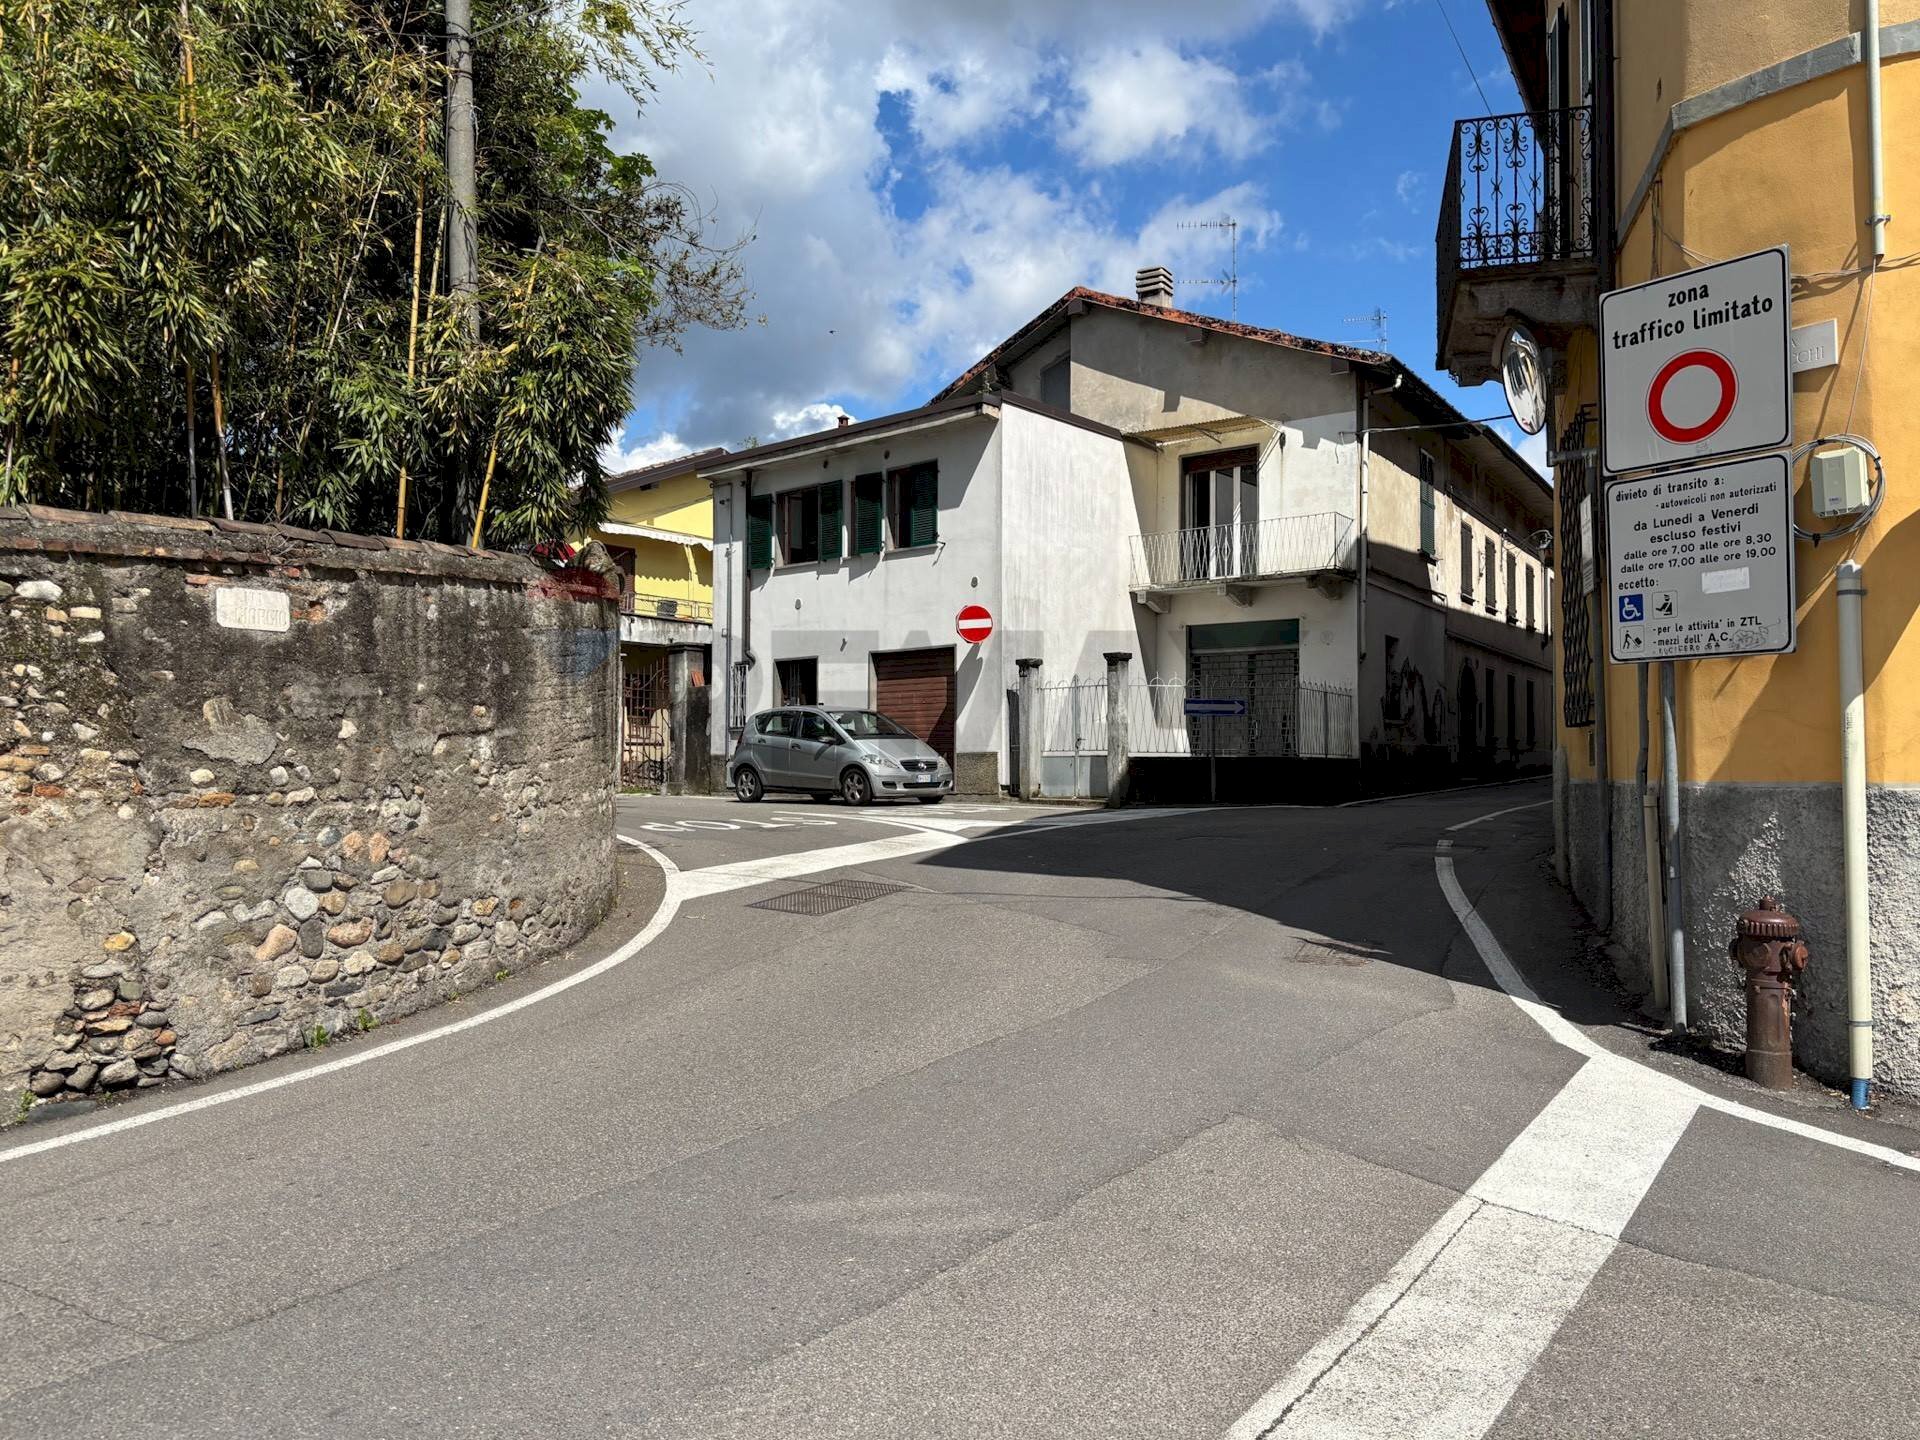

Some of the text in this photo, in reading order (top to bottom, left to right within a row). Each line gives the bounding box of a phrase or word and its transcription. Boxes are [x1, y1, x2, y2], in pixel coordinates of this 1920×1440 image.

[1668, 284, 1709, 308] zona
[1612, 295, 1773, 349] traffico limitato
[1615, 477, 1725, 502] divieto di transito a:
[1710, 491, 1726, 501] non
[1729, 481, 1777, 499] autorizzati
[1633, 502, 1759, 532] da Lunedi a Venerdi
[1650, 521, 1741, 544] escluso festivi
[1623, 550, 1648, 561] dalle
[1651, 548, 1668, 557] ore
[1699, 539, 1719, 551] alle
[1723, 539, 1741, 548] ore
[1620, 563, 1644, 574] dalle
[1648, 562, 1664, 570] ore
[1699, 553, 1719, 564] alle
[1723, 552, 1741, 561] ore
[1618, 577, 1660, 591] eccetto:
[1675, 622, 1684, 632] le
[1727, 617, 1735, 628] in
[1740, 615, 1762, 627] ZTL
[1708, 631, 1733, 643] A.C.
